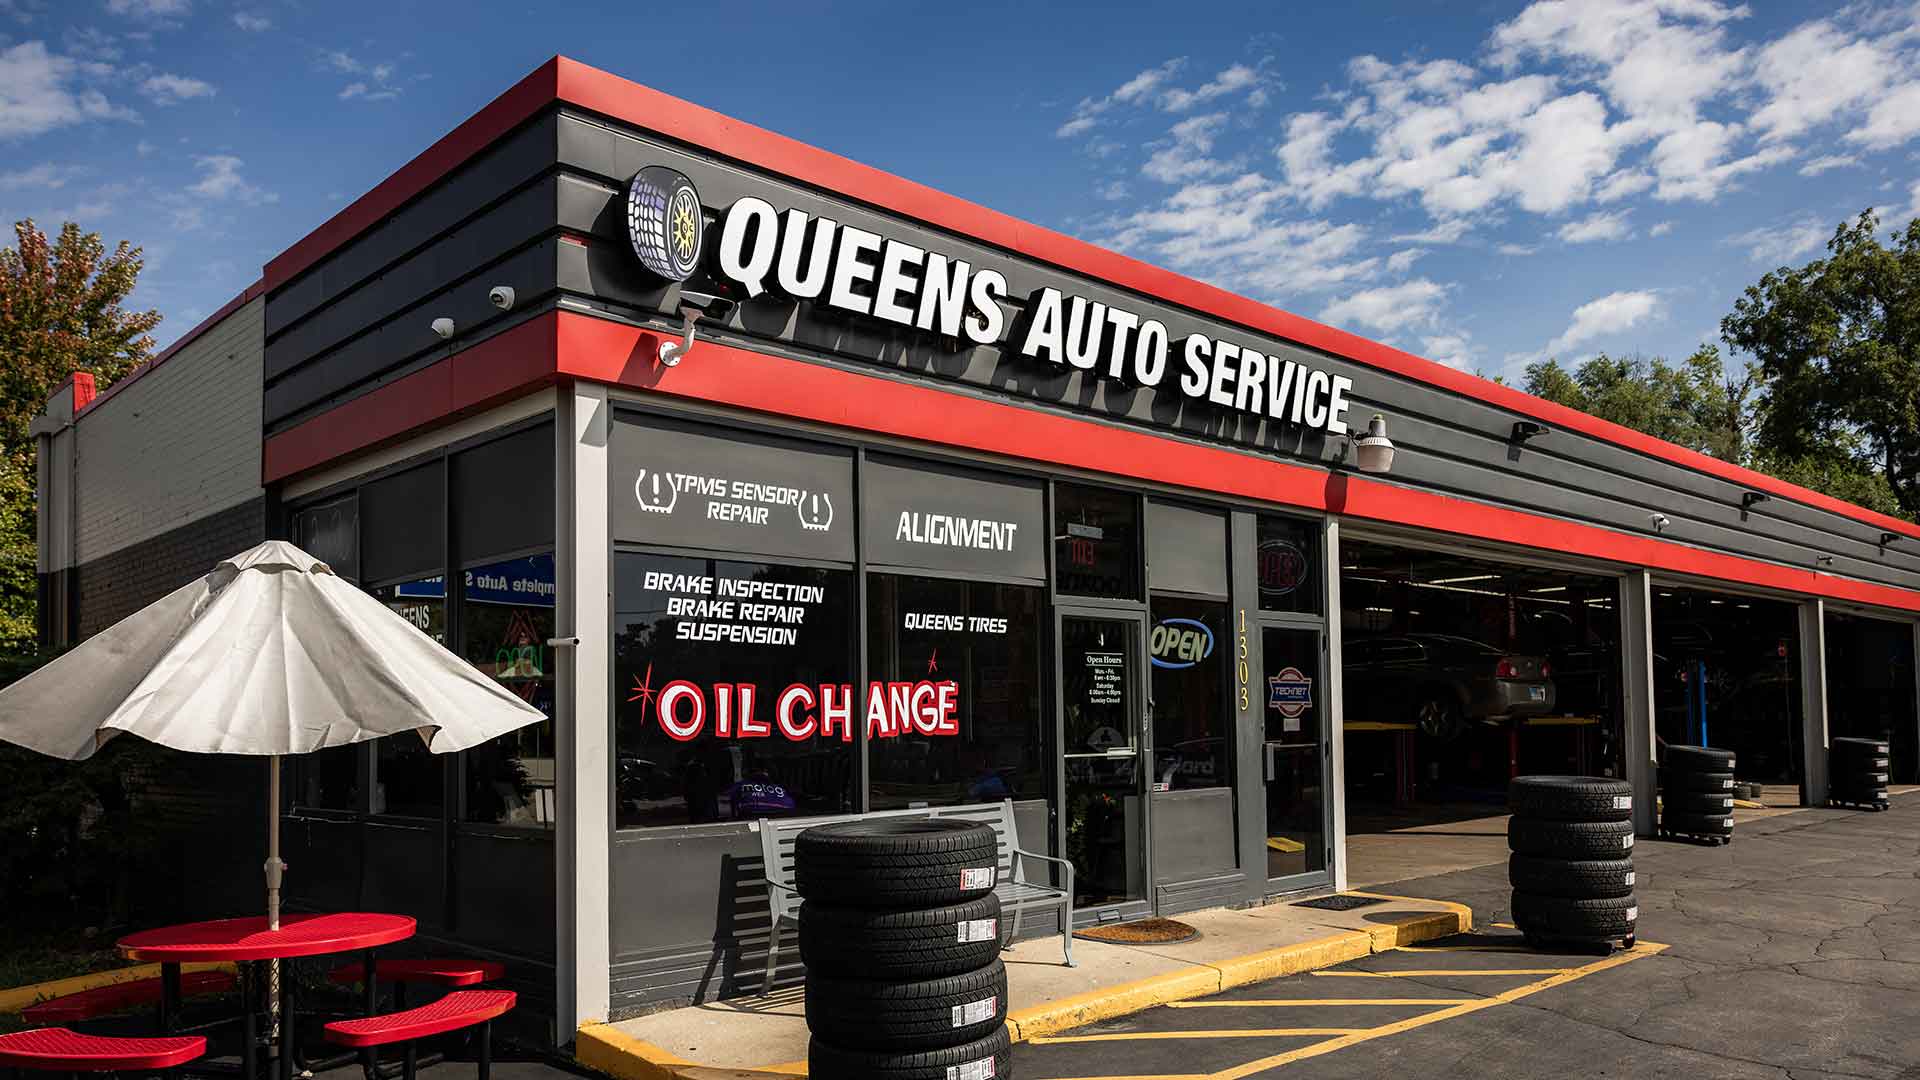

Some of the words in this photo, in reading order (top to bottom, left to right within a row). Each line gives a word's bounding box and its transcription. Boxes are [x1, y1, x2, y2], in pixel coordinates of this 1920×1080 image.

[719, 197, 1007, 344] QUEENS
[1021, 287, 1168, 386] AUTO
[1180, 333, 1353, 435] SERVICE
[675, 473, 728, 498] TPMS
[730, 481, 799, 506] SENSOR
[707, 501, 769, 526] REPAIR
[895, 511, 1018, 552] ALIGNMENT
[643, 571, 714, 596] BRAKE
[717, 578, 824, 604] INSPECTION
[666, 597, 736, 621] BRAKE
[739, 602, 805, 625] REPAIR
[904, 613, 964, 632] QUEENS
[968, 616, 1008, 634] TIRES
[675, 621, 797, 647] SUSPENSION
[1151, 625, 1207, 662] OPEN
[1087, 655, 1103, 664] Open
[1103, 656, 1122, 664] Hours
[1238, 609, 1249, 711] 1303
